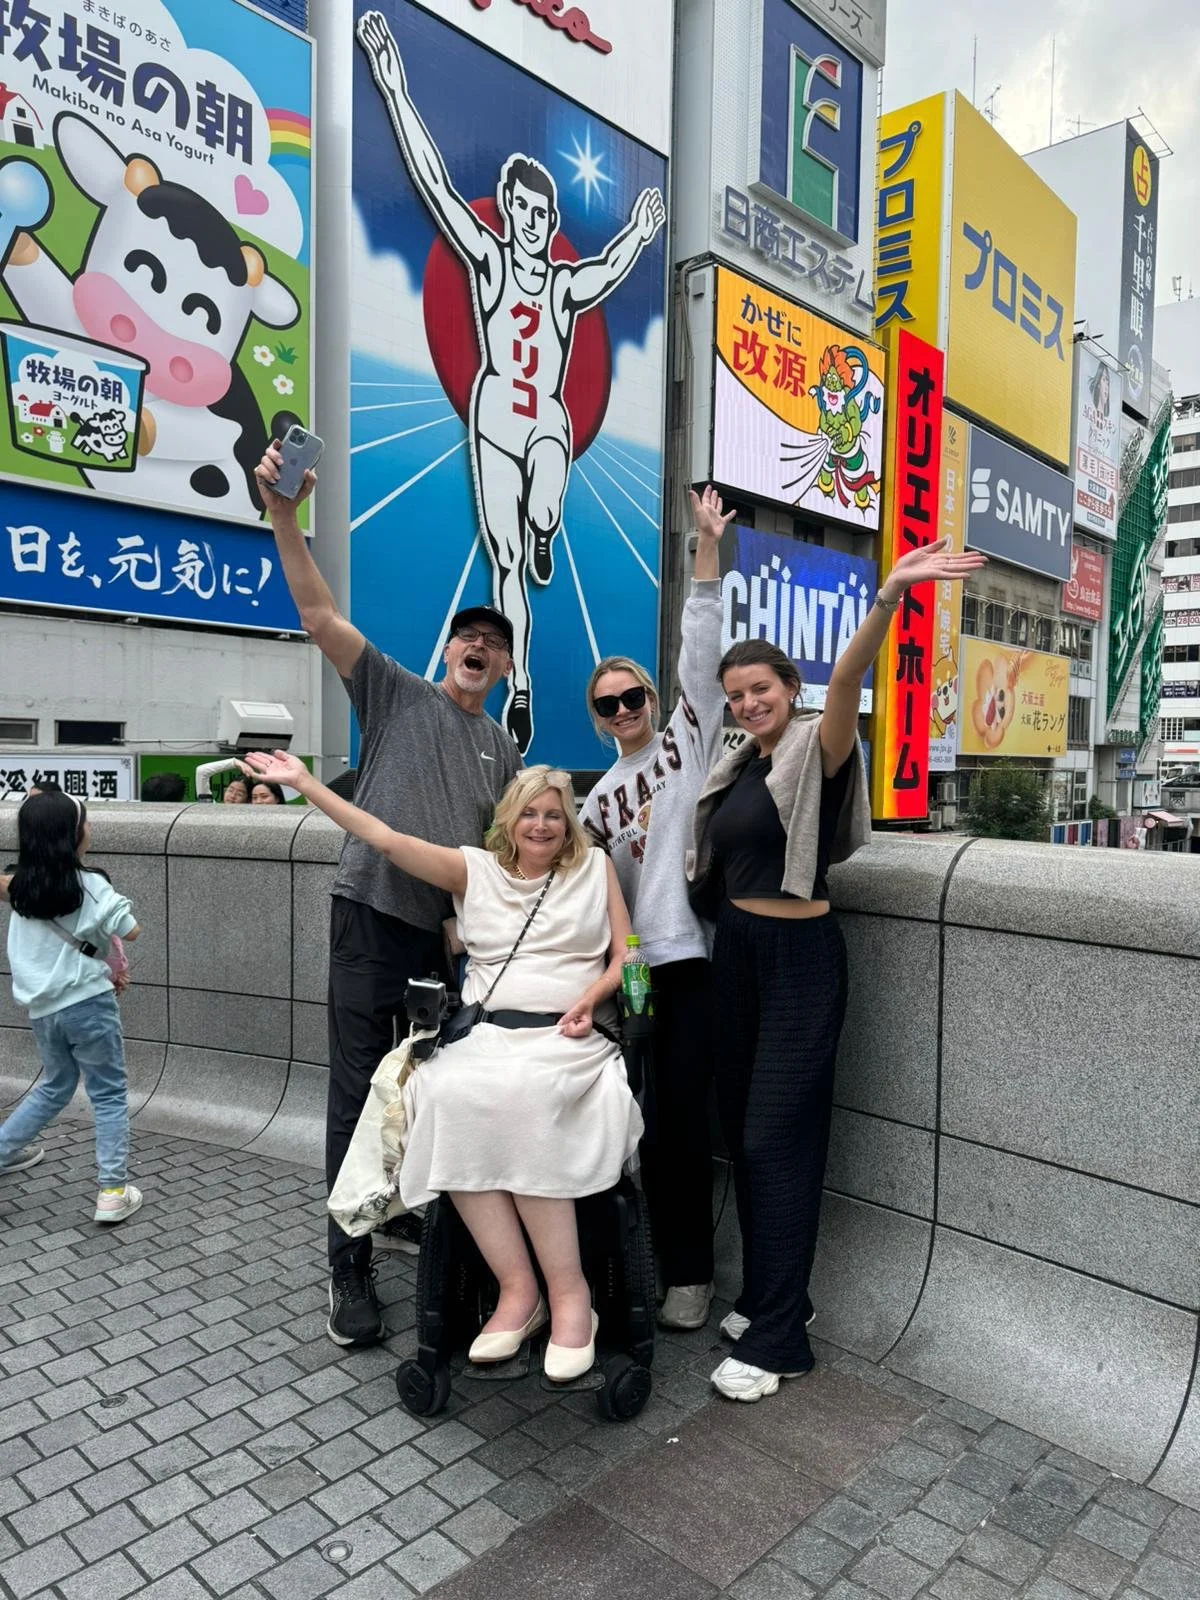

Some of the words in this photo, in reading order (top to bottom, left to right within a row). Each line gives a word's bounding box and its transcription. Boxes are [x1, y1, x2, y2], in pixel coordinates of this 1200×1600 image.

[31, 73, 100, 116] Makiba
[105, 108, 126, 127] no
[131, 118, 162, 144] Asa
[164, 131, 215, 166] Yogurt
[721, 184, 876, 314] 日商エステム
[875, 120, 922, 329] プロミス
[741, 294, 802, 347] かぜに
[962, 221, 1066, 363] プロミス
[26, 358, 123, 405] 牧場の朝
[52, 390, 99, 411] ヨーグルト
[510, 301, 542, 420] グリコ
[732, 324, 807, 398] 改源
[995, 478, 1071, 547] SAMTY
